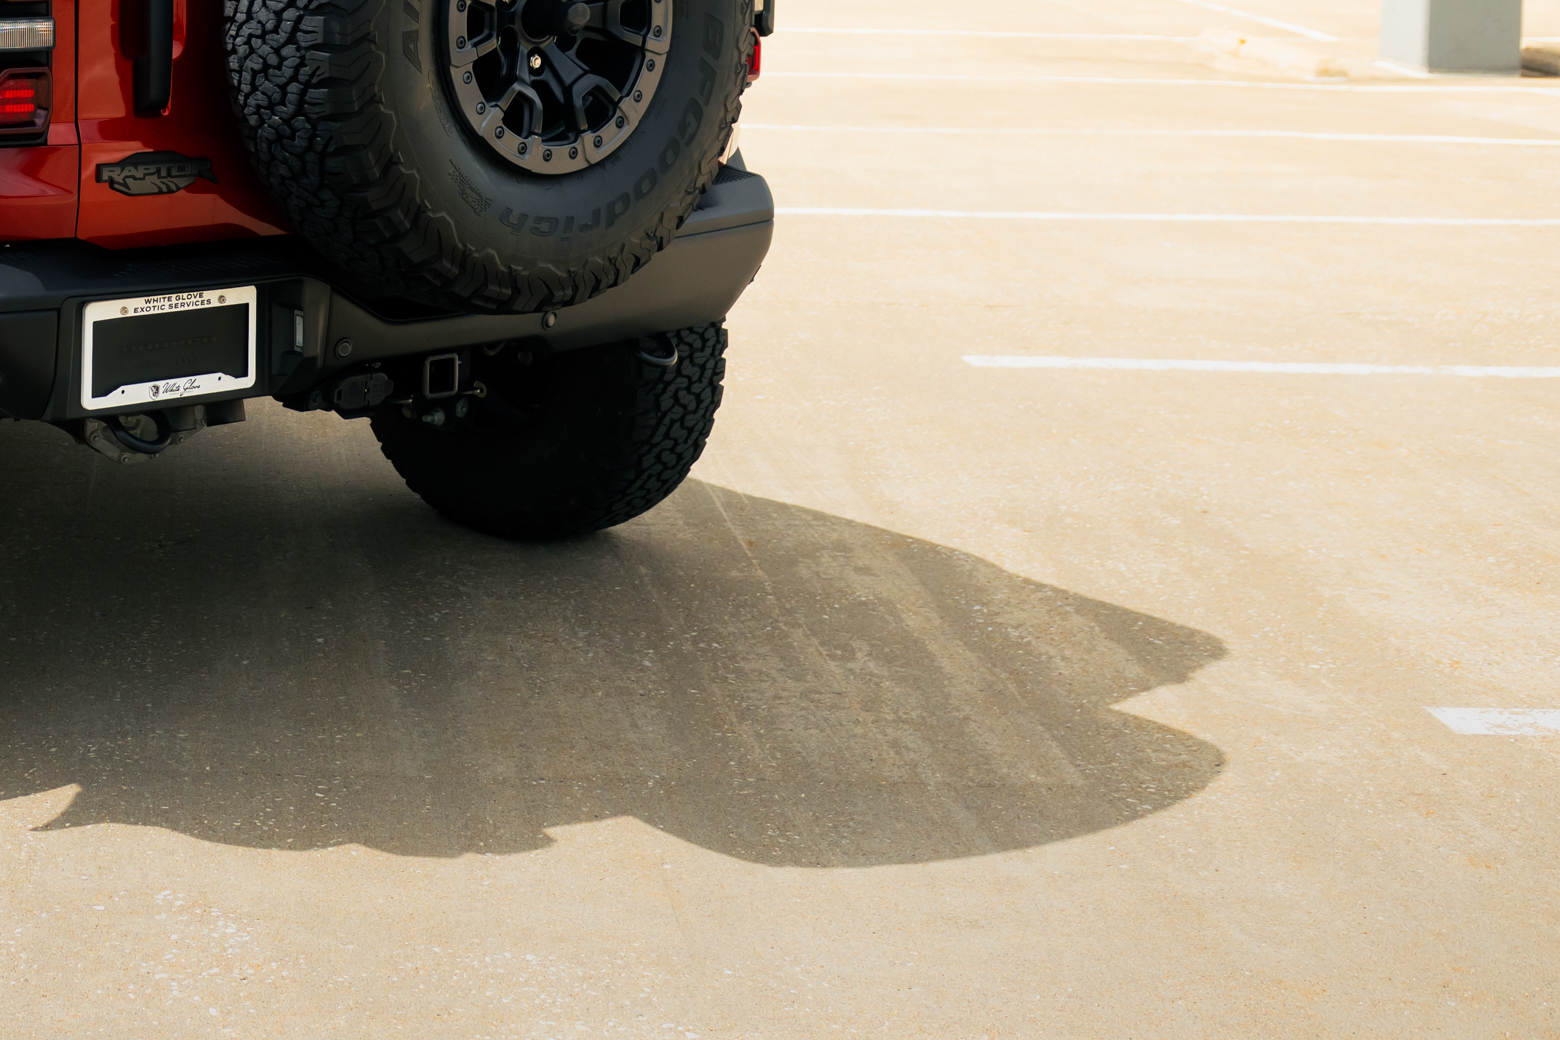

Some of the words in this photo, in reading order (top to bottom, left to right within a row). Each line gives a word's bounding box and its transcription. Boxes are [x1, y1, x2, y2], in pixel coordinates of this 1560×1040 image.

[499, 11, 724, 242] BFGoodrich
[101, 160, 218, 191] RAPTOR
[133, 304, 165, 313] EXOTIC
[168, 299, 211, 309] SERVICES
[144, 296, 173, 305] WHITE
[175, 292, 204, 301] GLOVE
[162, 382, 181, 394] White
[179, 378, 201, 396] Glove
